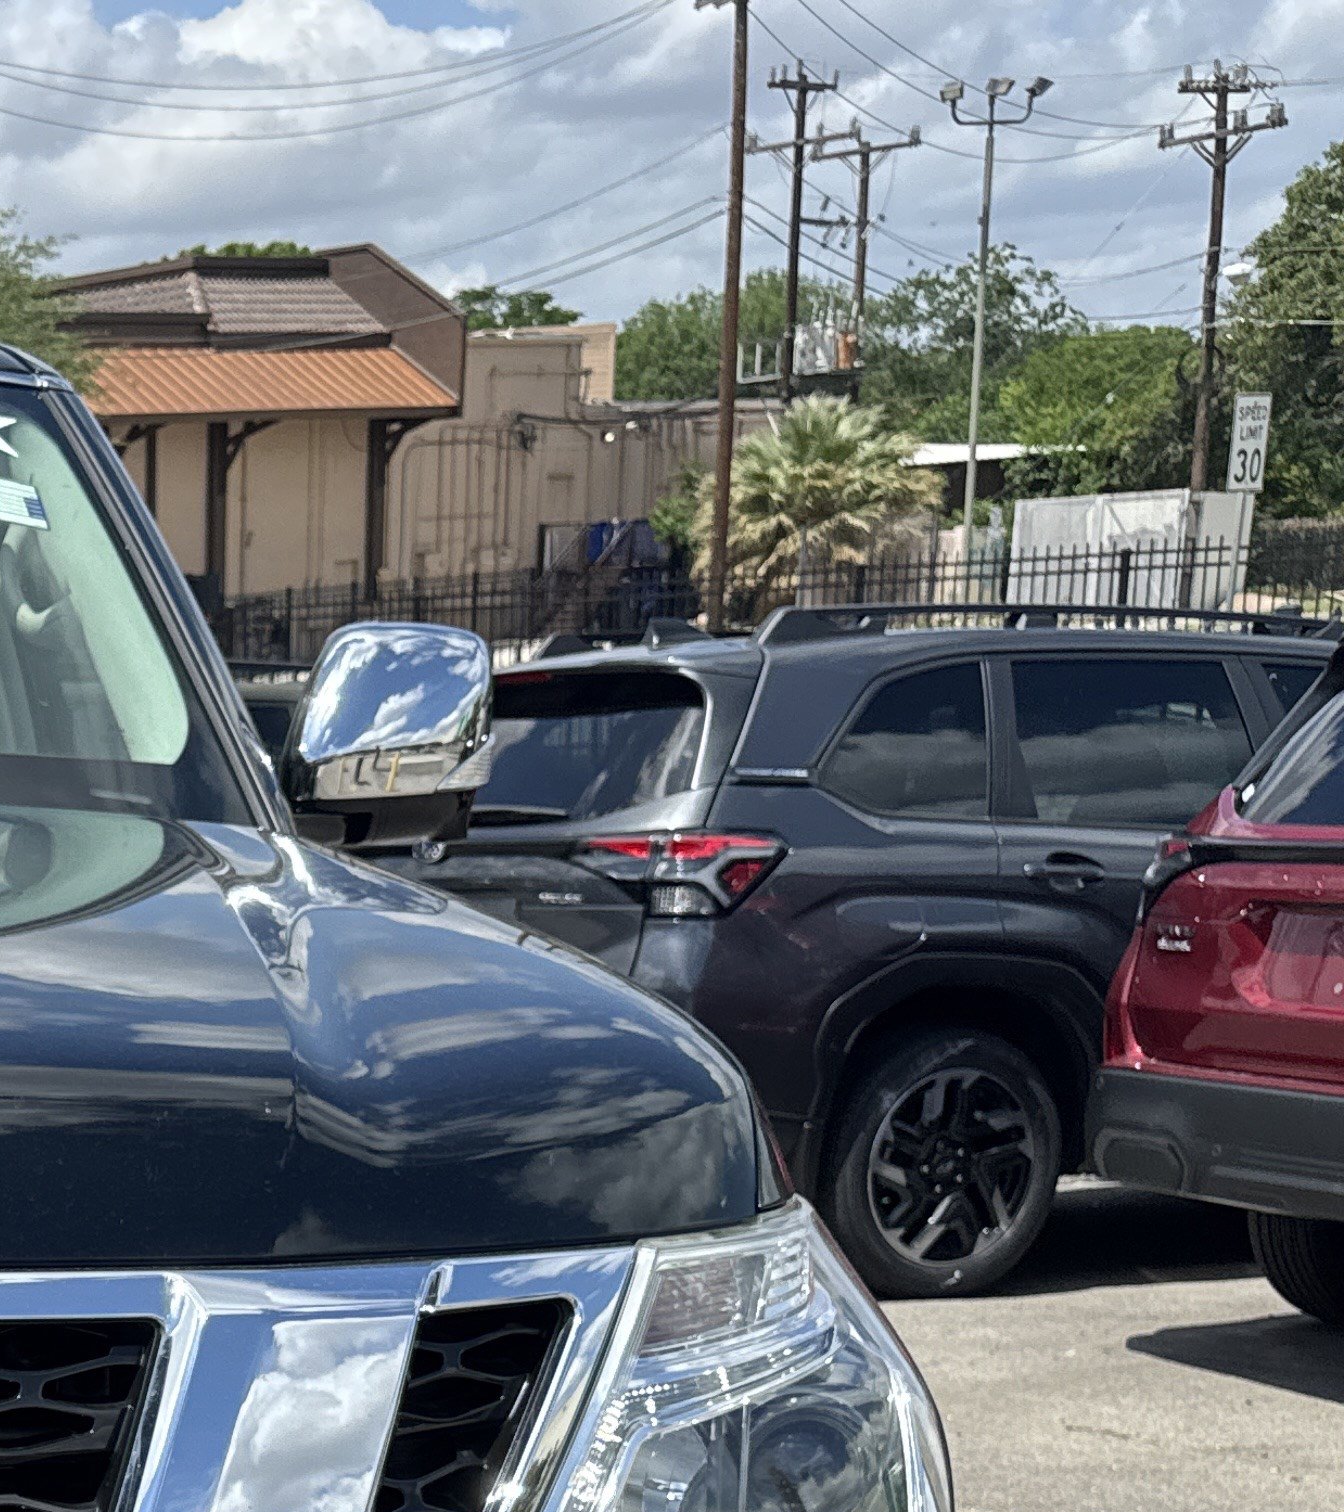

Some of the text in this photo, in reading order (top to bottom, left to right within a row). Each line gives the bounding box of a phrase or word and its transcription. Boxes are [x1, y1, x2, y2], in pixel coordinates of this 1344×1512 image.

[1238, 404, 1268, 422] SPEED
[1239, 424, 1264, 441] LIMIT
[1233, 447, 1262, 483] 30
